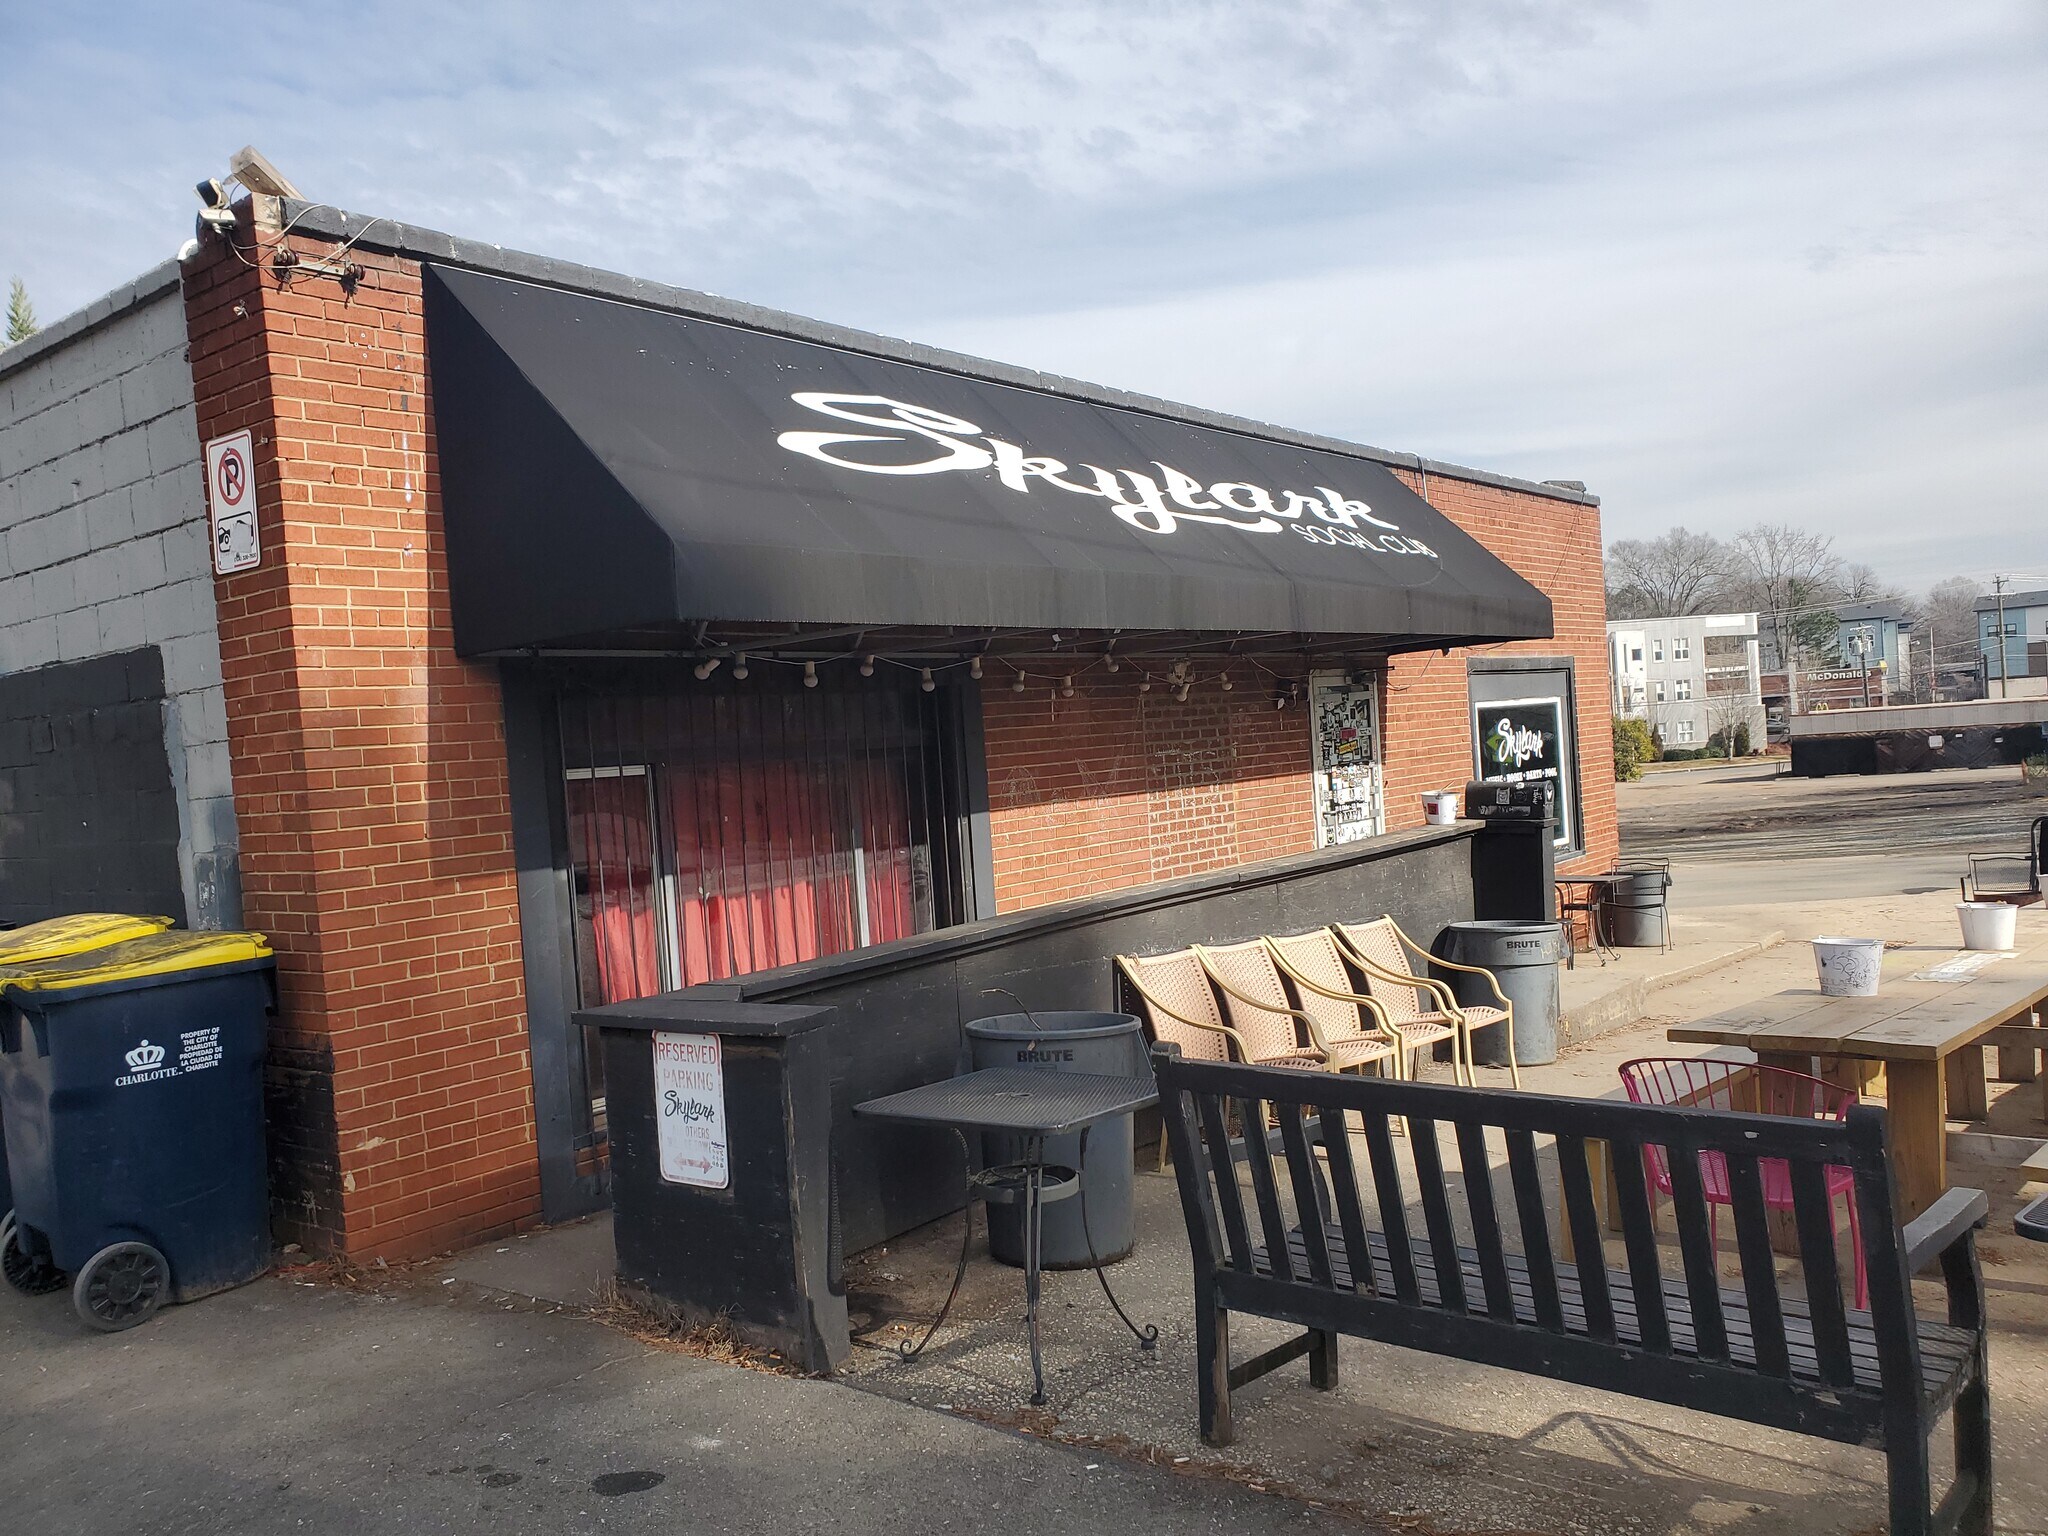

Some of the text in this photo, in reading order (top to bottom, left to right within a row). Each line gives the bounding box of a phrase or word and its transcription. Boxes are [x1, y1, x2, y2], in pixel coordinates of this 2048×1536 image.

[776, 391, 1400, 534] Skylark
[1290, 523, 1438, 558] SOCIAL CLUB
[1807, 670, 1872, 681] McDonalds
[1497, 718, 1544, 767] Skylark
[1506, 940, 1541, 949] BRUTE
[180, 1026, 220, 1040] PROPERTY OF
[183, 1038, 195, 1046] THE
[196, 1036, 209, 1044] CITY
[184, 1040, 218, 1053] CHARLOTTE
[180, 1048, 214, 1060] PROPIEDAD
[658, 1041, 717, 1065] RESERVED
[1017, 1050, 1074, 1063] BRUTE
[185, 1060, 219, 1073] CHARLOTTE
[190, 1055, 214, 1066] CIUDAD
[115, 1067, 179, 1087] CHARLOTTE
[664, 1090, 715, 1125] Skylark
